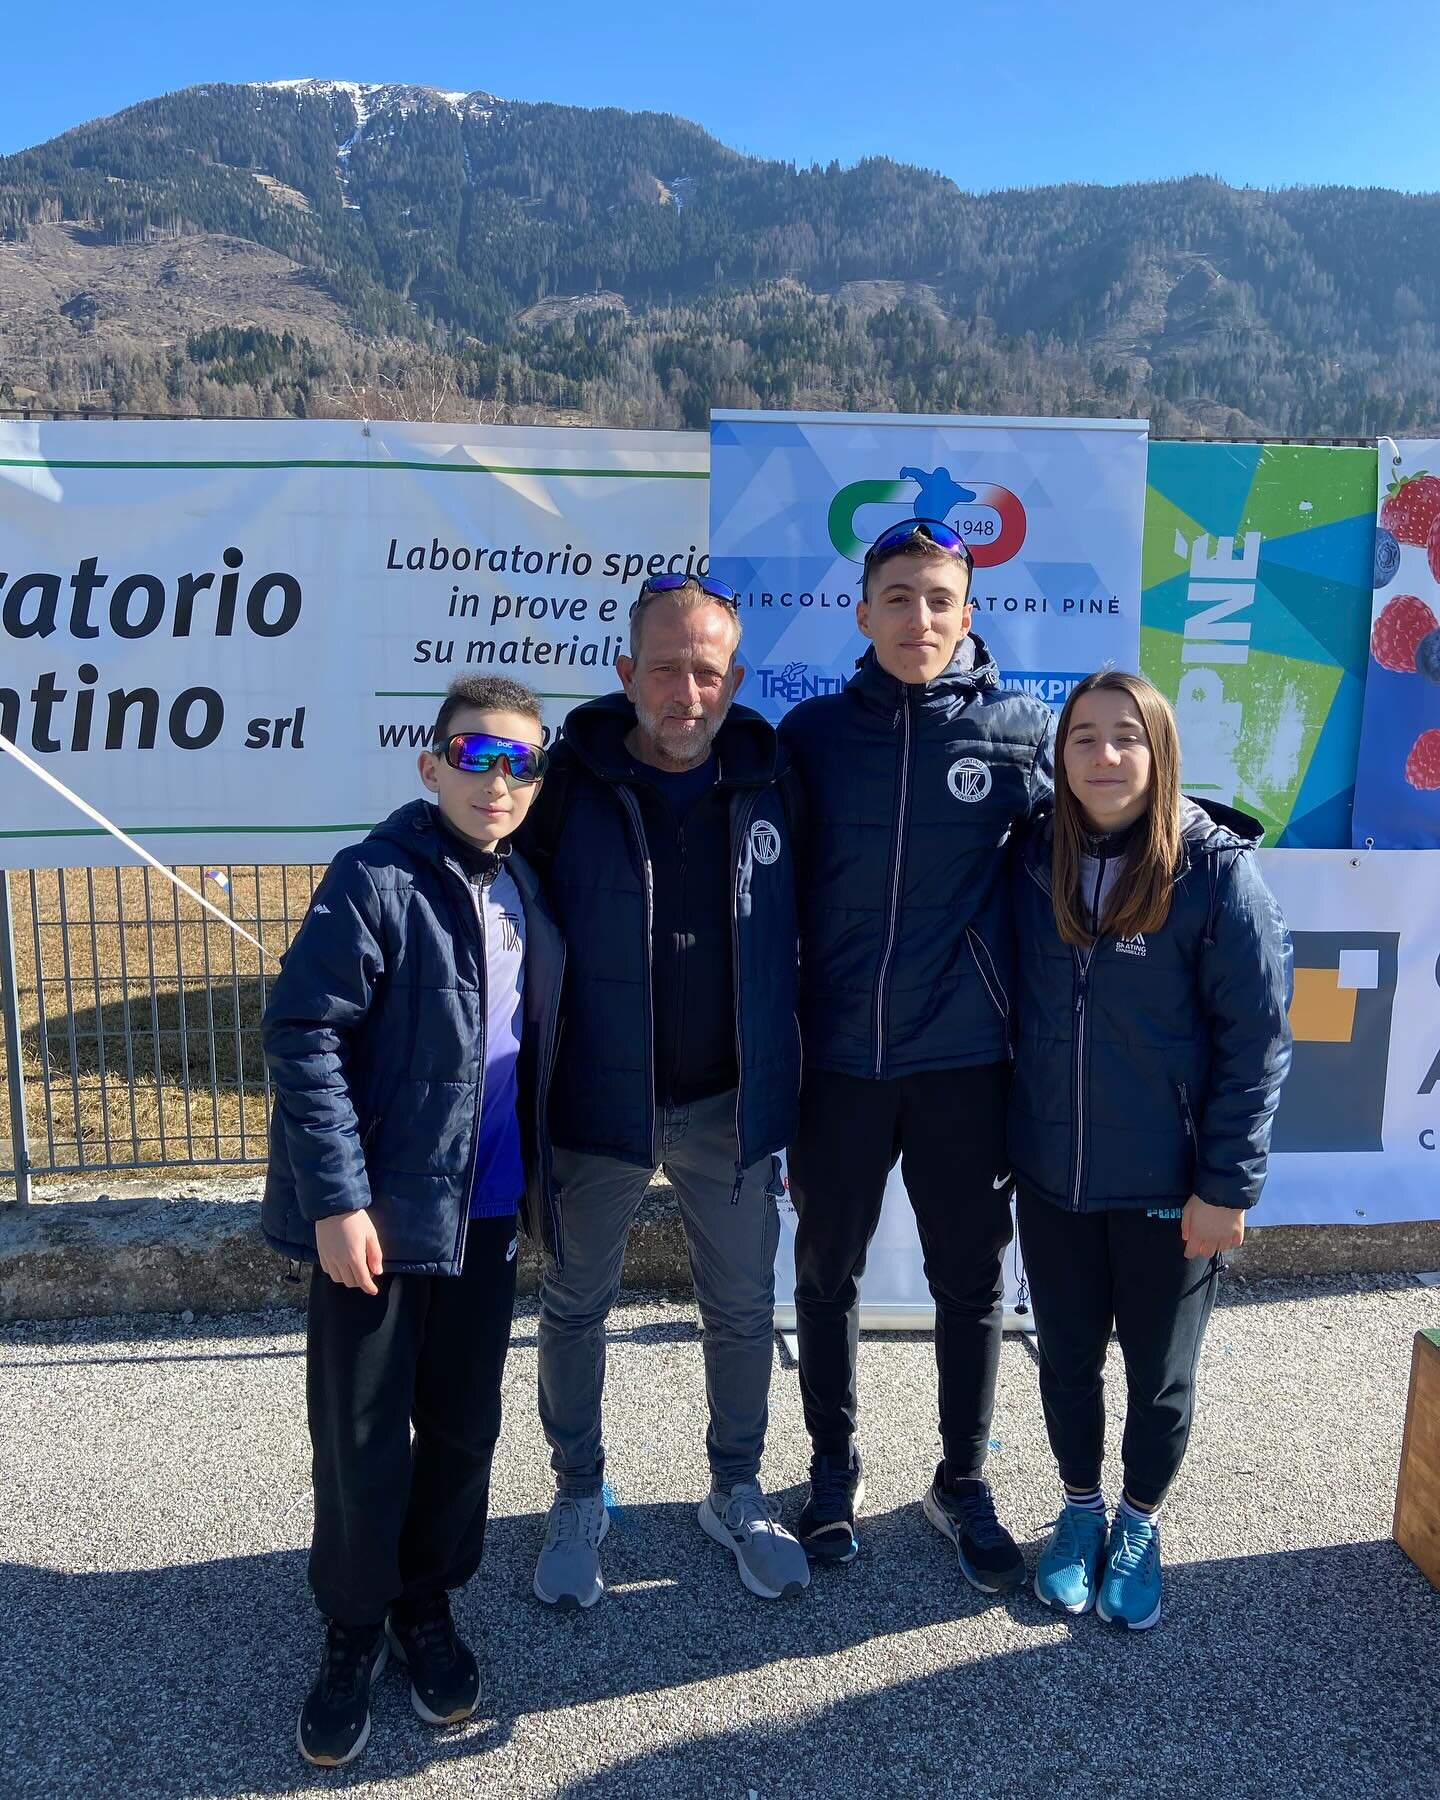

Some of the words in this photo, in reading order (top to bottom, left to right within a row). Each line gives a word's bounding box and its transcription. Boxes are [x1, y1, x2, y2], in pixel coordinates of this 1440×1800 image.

[953, 519, 994, 536] 1948
[387, 538, 593, 576] Laboratorio
[0, 546, 302, 639] atorio
[448, 585, 480, 618] in
[490, 595, 588, 626] prove
[598, 598, 618, 622] e
[969, 596, 1047, 613] ATORI
[1062, 595, 1120, 614] PINÉ
[413, 638, 455, 664] su
[465, 634, 623, 667] materiali
[244, 706, 306, 750] srl
